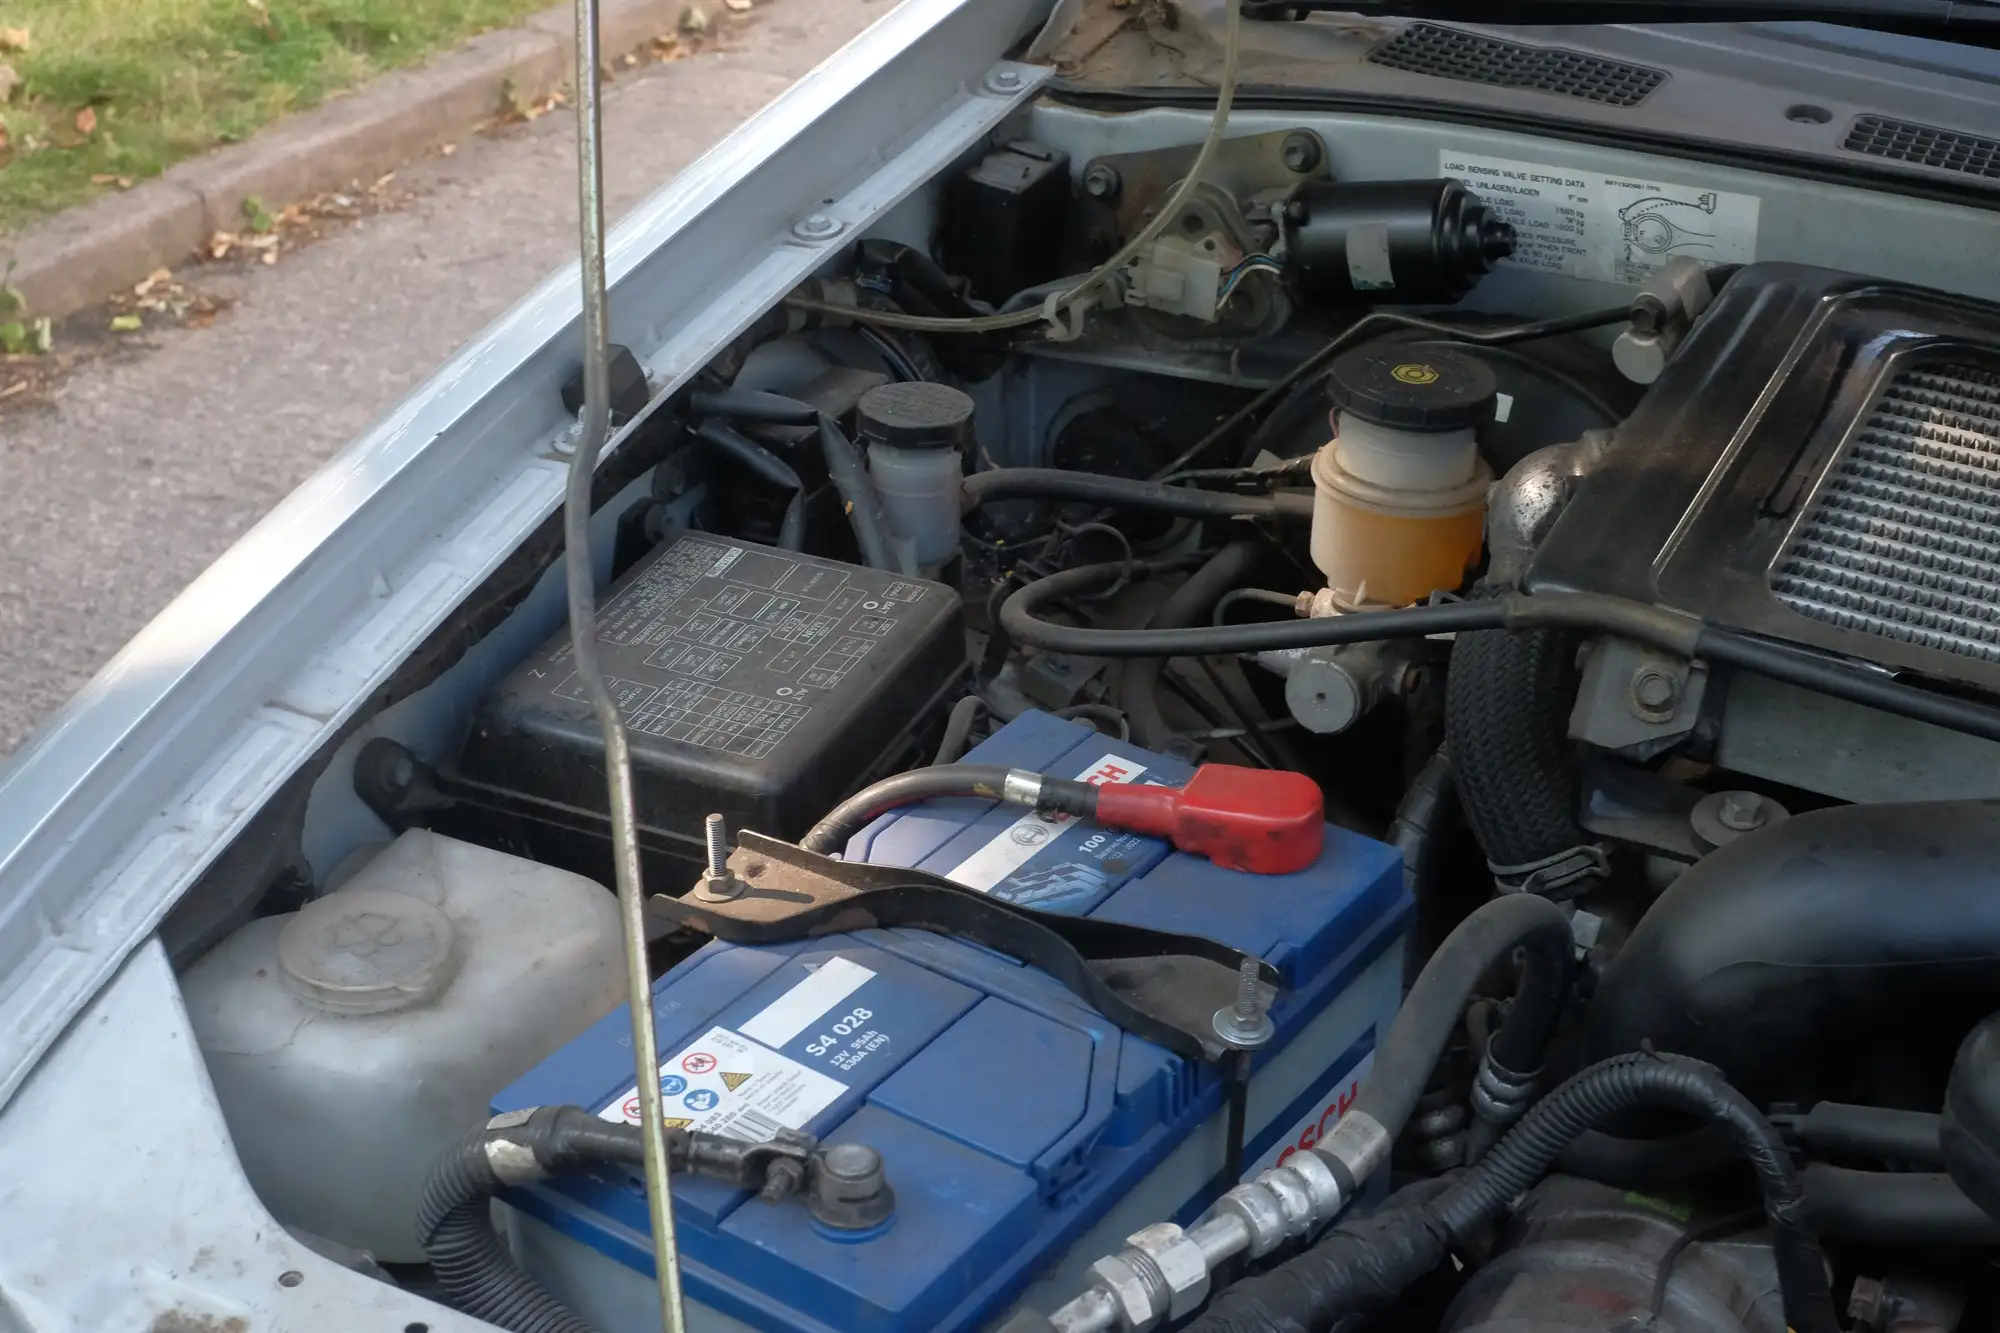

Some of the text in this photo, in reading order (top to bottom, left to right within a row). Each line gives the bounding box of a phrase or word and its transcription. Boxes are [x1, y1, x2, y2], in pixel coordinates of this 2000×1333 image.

[1444, 162, 1586, 189] LOAD SENSING VALVE SETTING DATA
[1476, 181, 1540, 197] UNLADEN/LADEN
[876, 600, 897, 615] BAT
[778, 616, 802, 633] ECM
[800, 620, 825, 639] MAIN
[789, 686, 811, 702] ALT
[1078, 834, 1106, 853] 100
[805, 1007, 873, 1057] S4 028
[830, 1030, 878, 1066] 12V 95Ah
[840, 1033, 890, 1071] 830A (EN)
